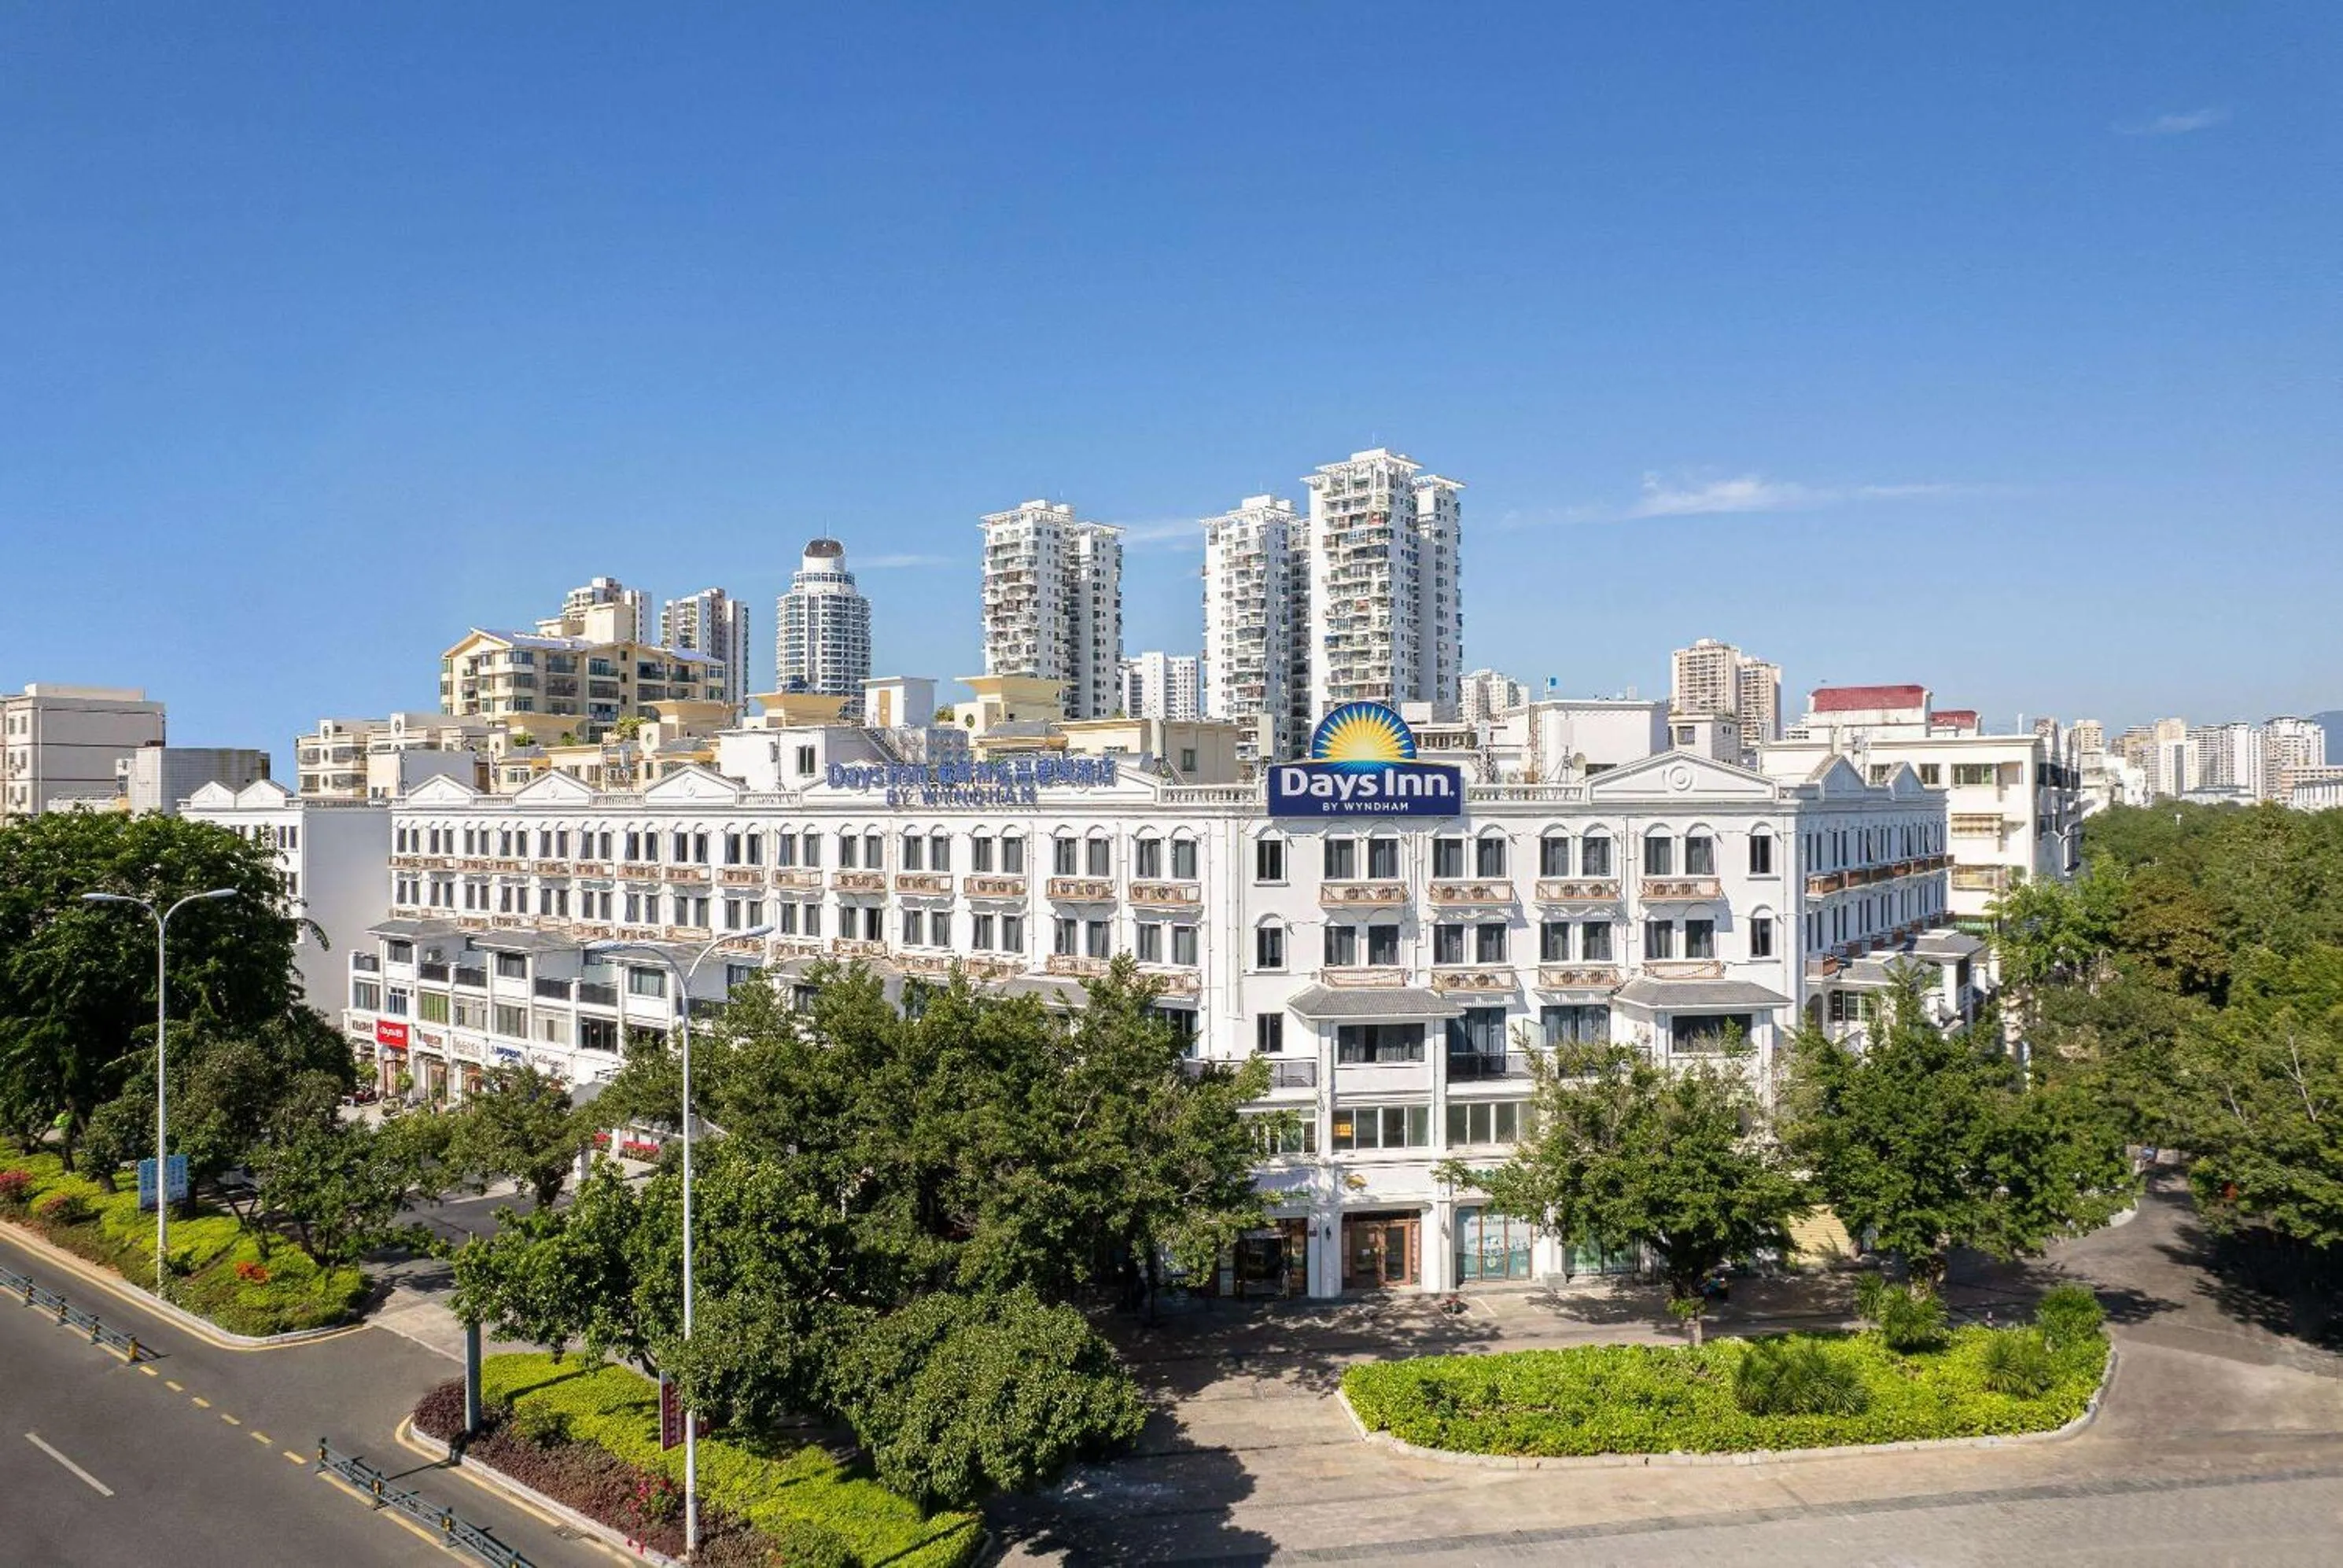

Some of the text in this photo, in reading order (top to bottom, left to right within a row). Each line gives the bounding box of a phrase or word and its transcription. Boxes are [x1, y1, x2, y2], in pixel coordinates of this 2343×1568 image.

[1280, 767, 1379, 801] Days
[1322, 802, 1409, 812] BY WYNDHAM
